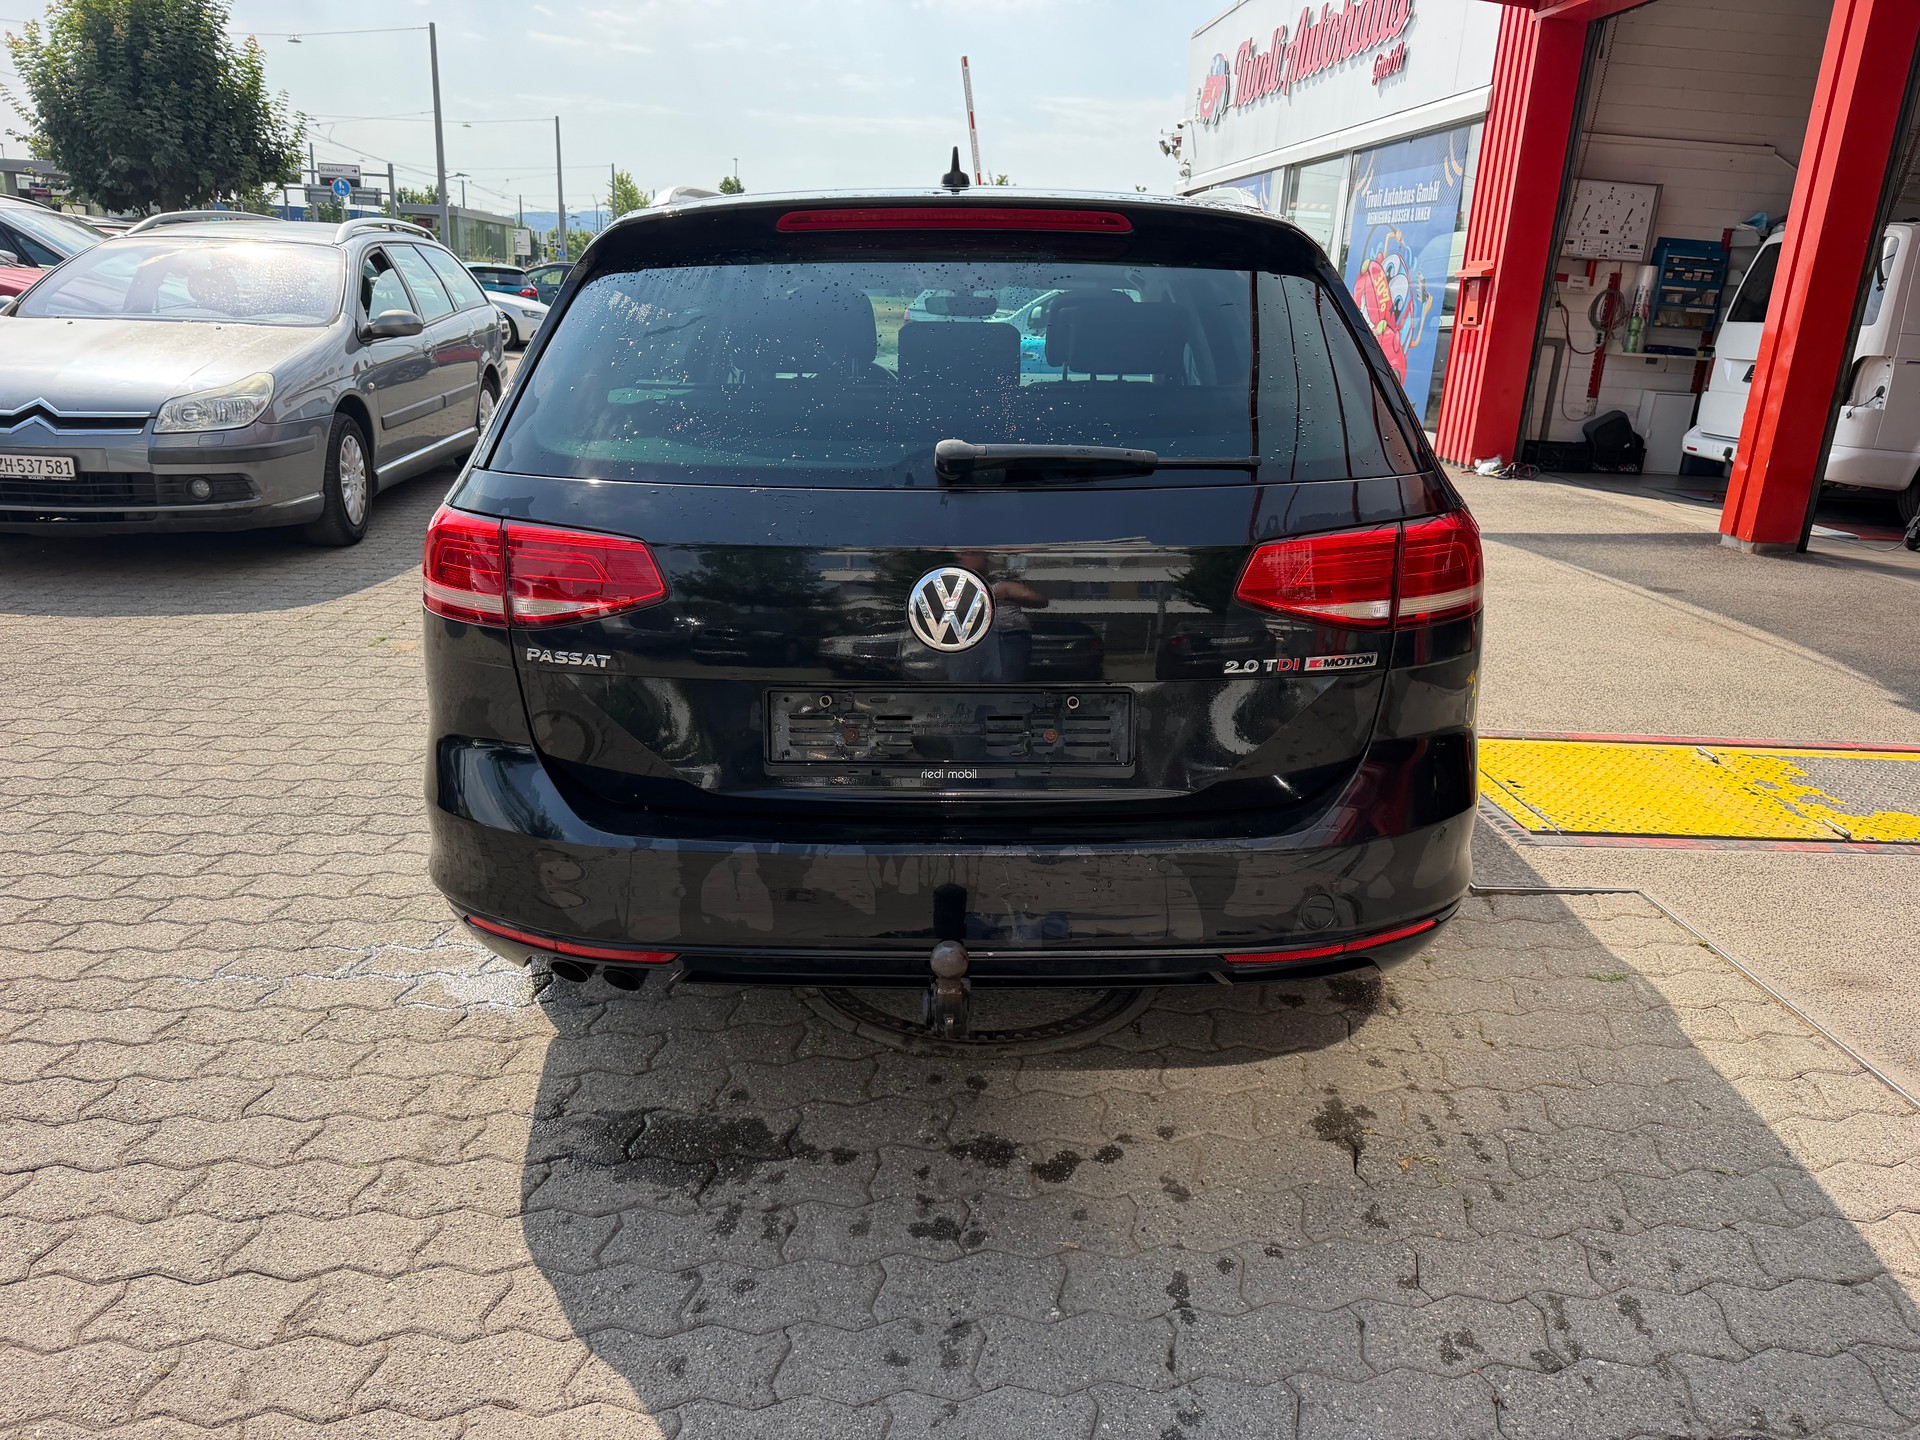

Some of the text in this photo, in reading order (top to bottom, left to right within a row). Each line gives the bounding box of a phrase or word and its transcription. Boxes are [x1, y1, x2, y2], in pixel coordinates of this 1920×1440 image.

[1233, 0, 1413, 108] Tivoli Autohaus
[1371, 41, 1405, 87] GmbH
[1366, 180, 1440, 209] Tivoli Autohaus GmbH
[1375, 270, 1390, 312] 30%
[908, 568, 992, 651] VW
[526, 647, 611, 668] PASSAT
[1223, 659, 1260, 674] 2.0
[1263, 657, 1300, 672] TDI
[921, 768, 977, 779] riedi mobil
